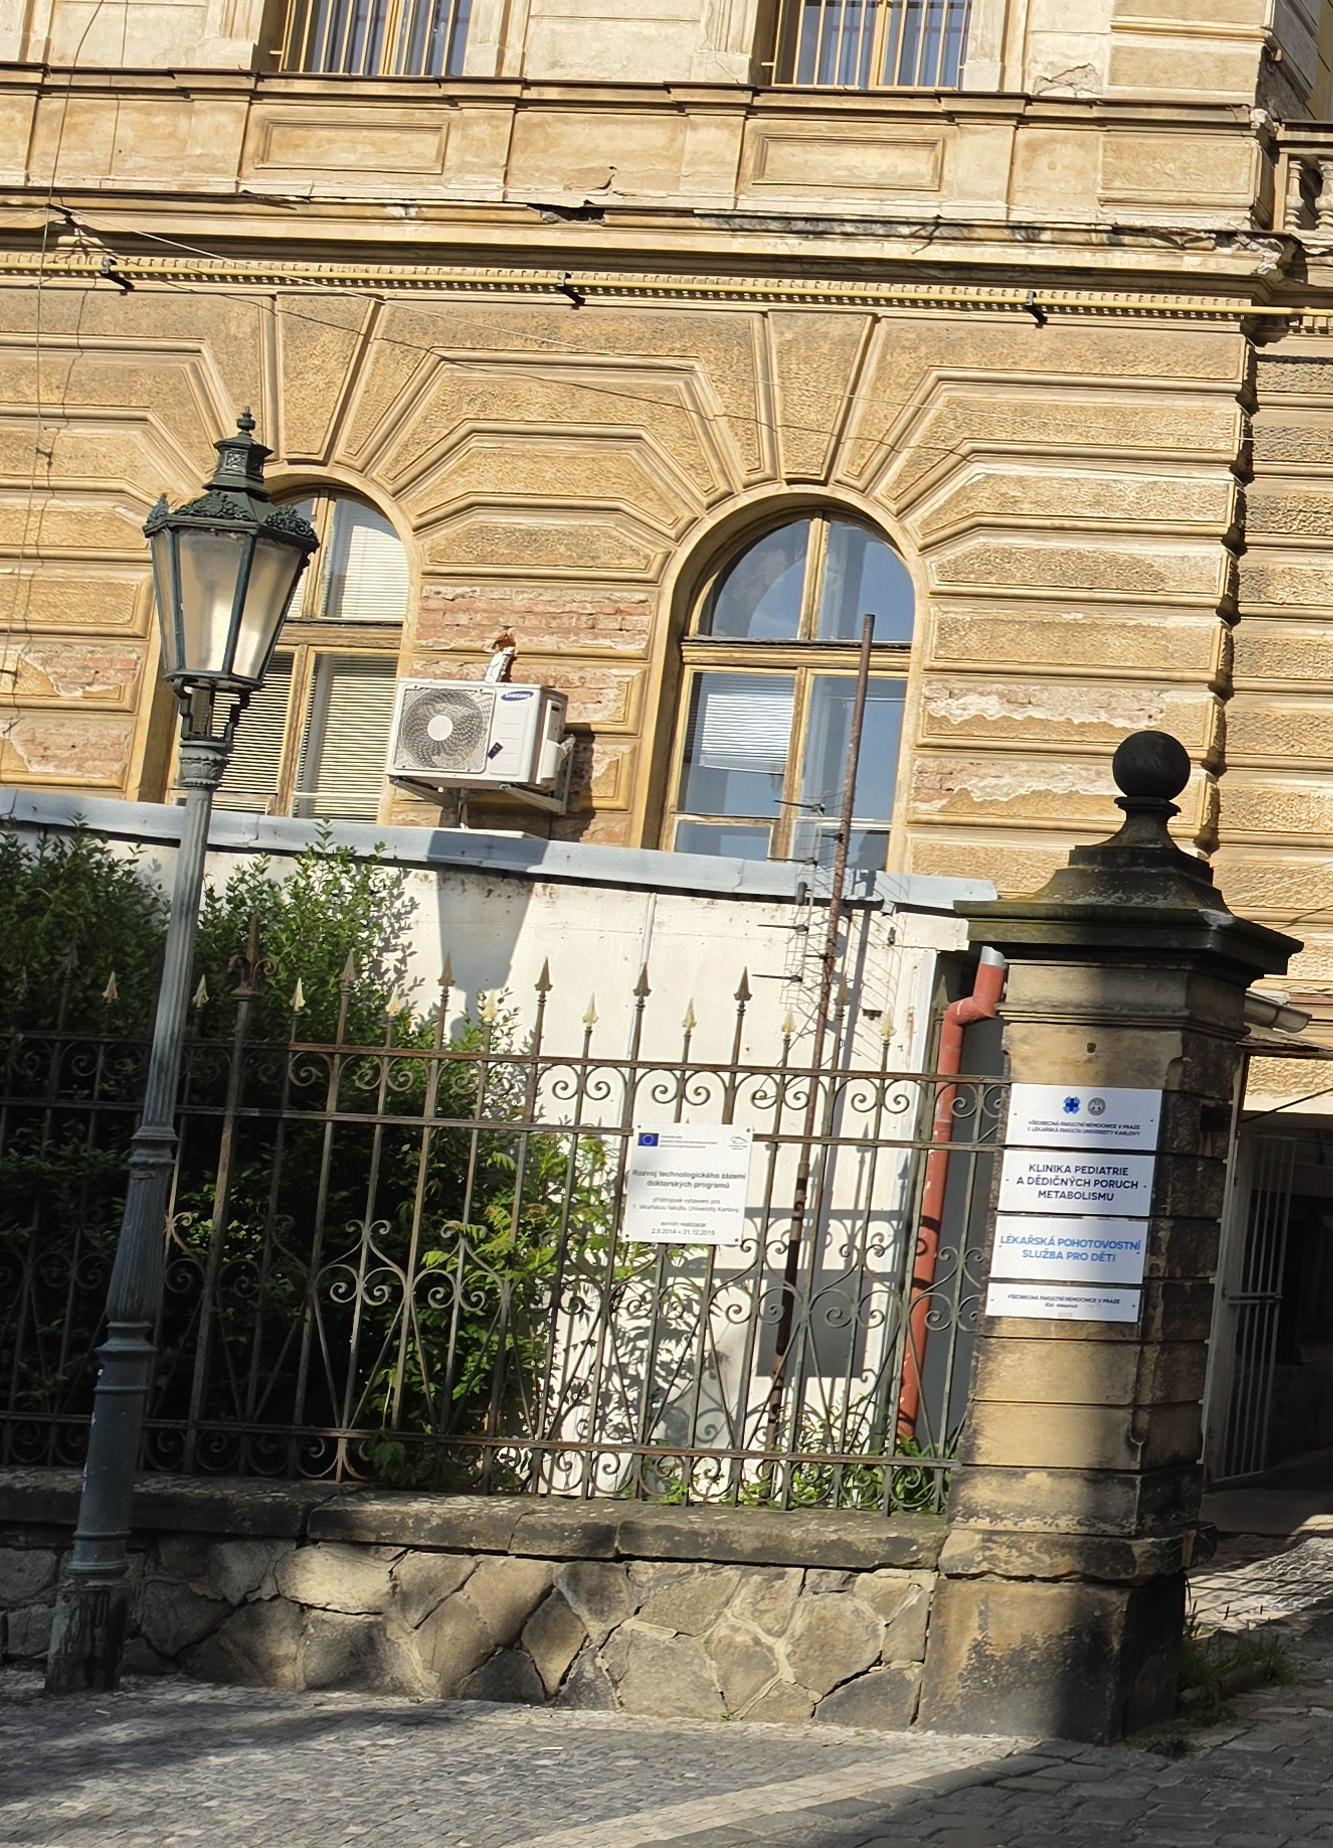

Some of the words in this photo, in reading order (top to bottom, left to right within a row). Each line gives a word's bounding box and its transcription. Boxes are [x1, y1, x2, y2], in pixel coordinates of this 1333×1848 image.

[1028, 1163, 1072, 1174] KLINIKA
[1074, 1165, 1129, 1176] PEDIATRIE
[1016, 1176, 1025, 1185] A
[1027, 1174, 1091, 1187] DĚDIČNÝCH
[1093, 1179, 1139, 1190] PORUCH
[1038, 1190, 1115, 1201] METABOLISMU
[1000, 1235, 1056, 1246] LÉKAŘSKÁ
[1057, 1238, 1142, 1251] POHOTOVOSTNÍ
[1022, 1248, 1063, 1260] SLUŽBA
[1066, 1251, 1089, 1261] PRO
[1091, 1251, 1116, 1262] DĚTI
